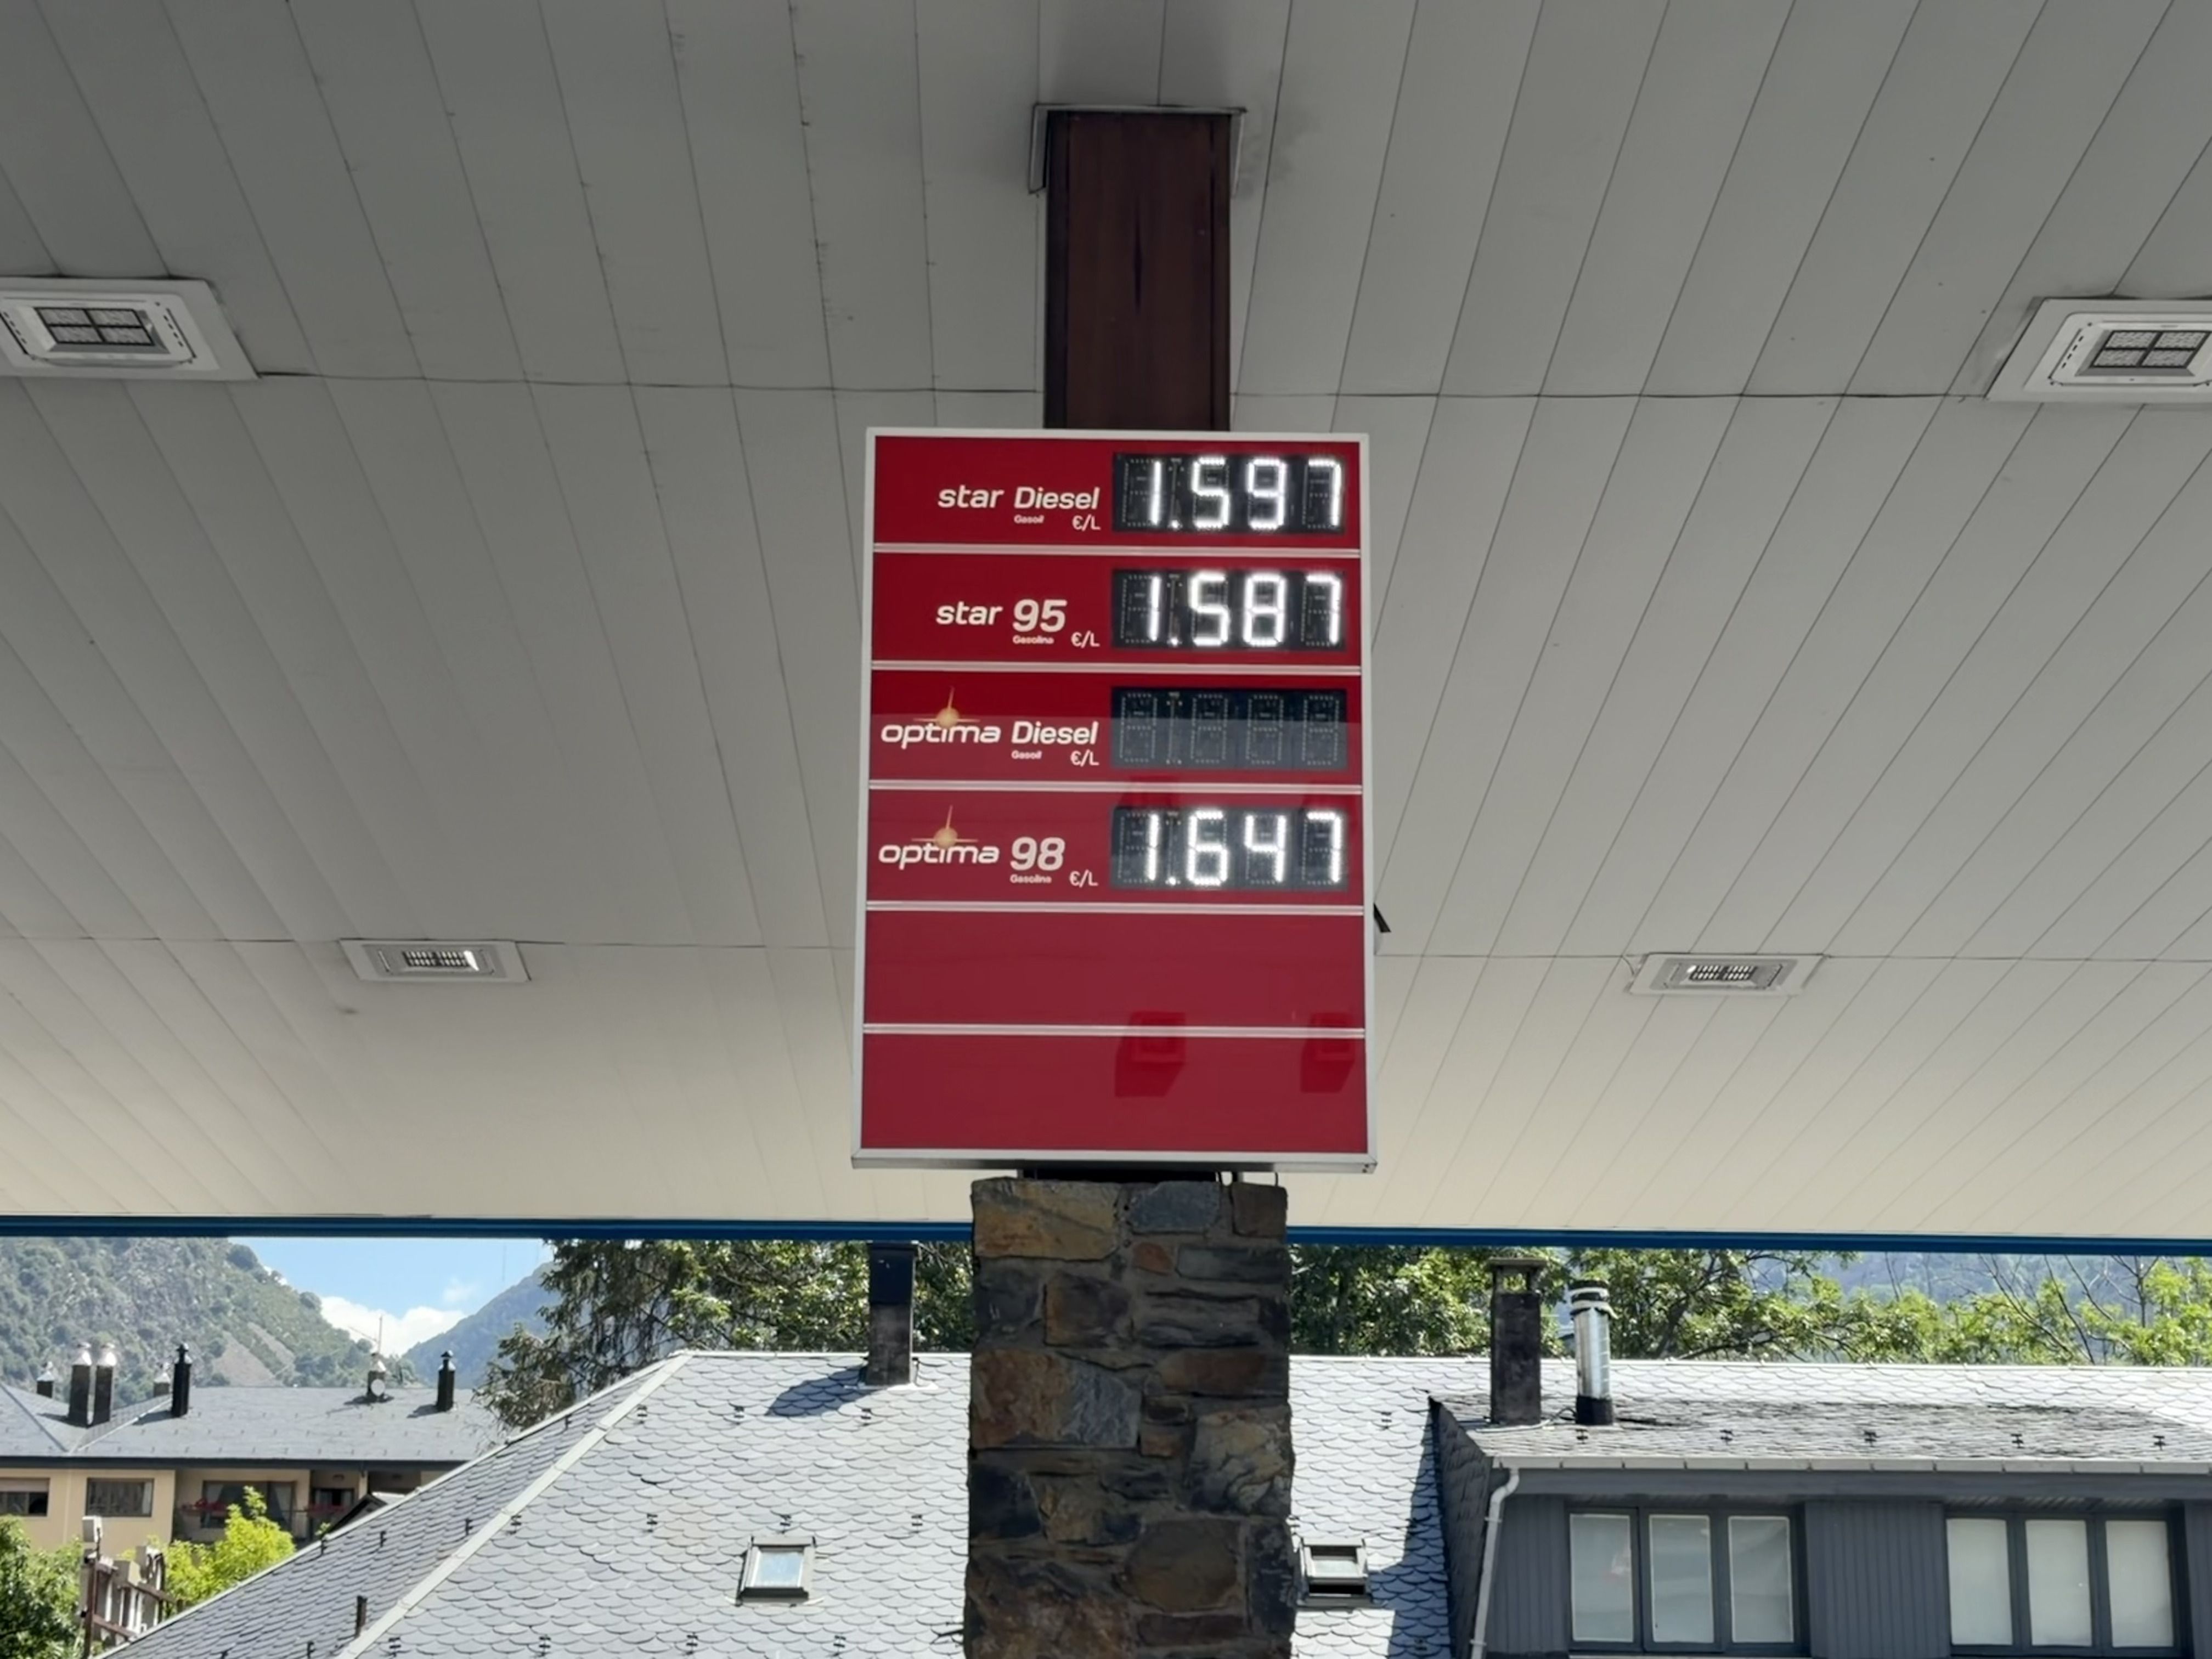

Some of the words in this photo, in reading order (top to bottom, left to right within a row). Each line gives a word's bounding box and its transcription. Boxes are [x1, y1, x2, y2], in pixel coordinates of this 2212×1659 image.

[939, 486, 1003, 507] star
[1015, 487, 1099, 509] Diesel
[1152, 458, 1341, 529] 1.597
[1014, 515, 1045, 523] Gasoil
[1073, 515, 1101, 531] €/L
[936, 602, 1002, 624] star
[1013, 600, 1068, 633] 95
[1150, 573, 1340, 646] 1.587
[1012, 635, 1055, 644] Gasolina
[1071, 631, 1100, 648] €/L
[881, 723, 1001, 749] optima
[1012, 721, 1098, 744] Diesel
[1011, 749, 1043, 759] Gasoil
[1070, 749, 1099, 766] €/L
[879, 843, 999, 869] optima
[1011, 837, 1065, 870] 98
[1148, 811, 1341, 885] 1.647
[1009, 874, 1053, 883] Gasolina
[1069, 870, 1098, 887] €/L
